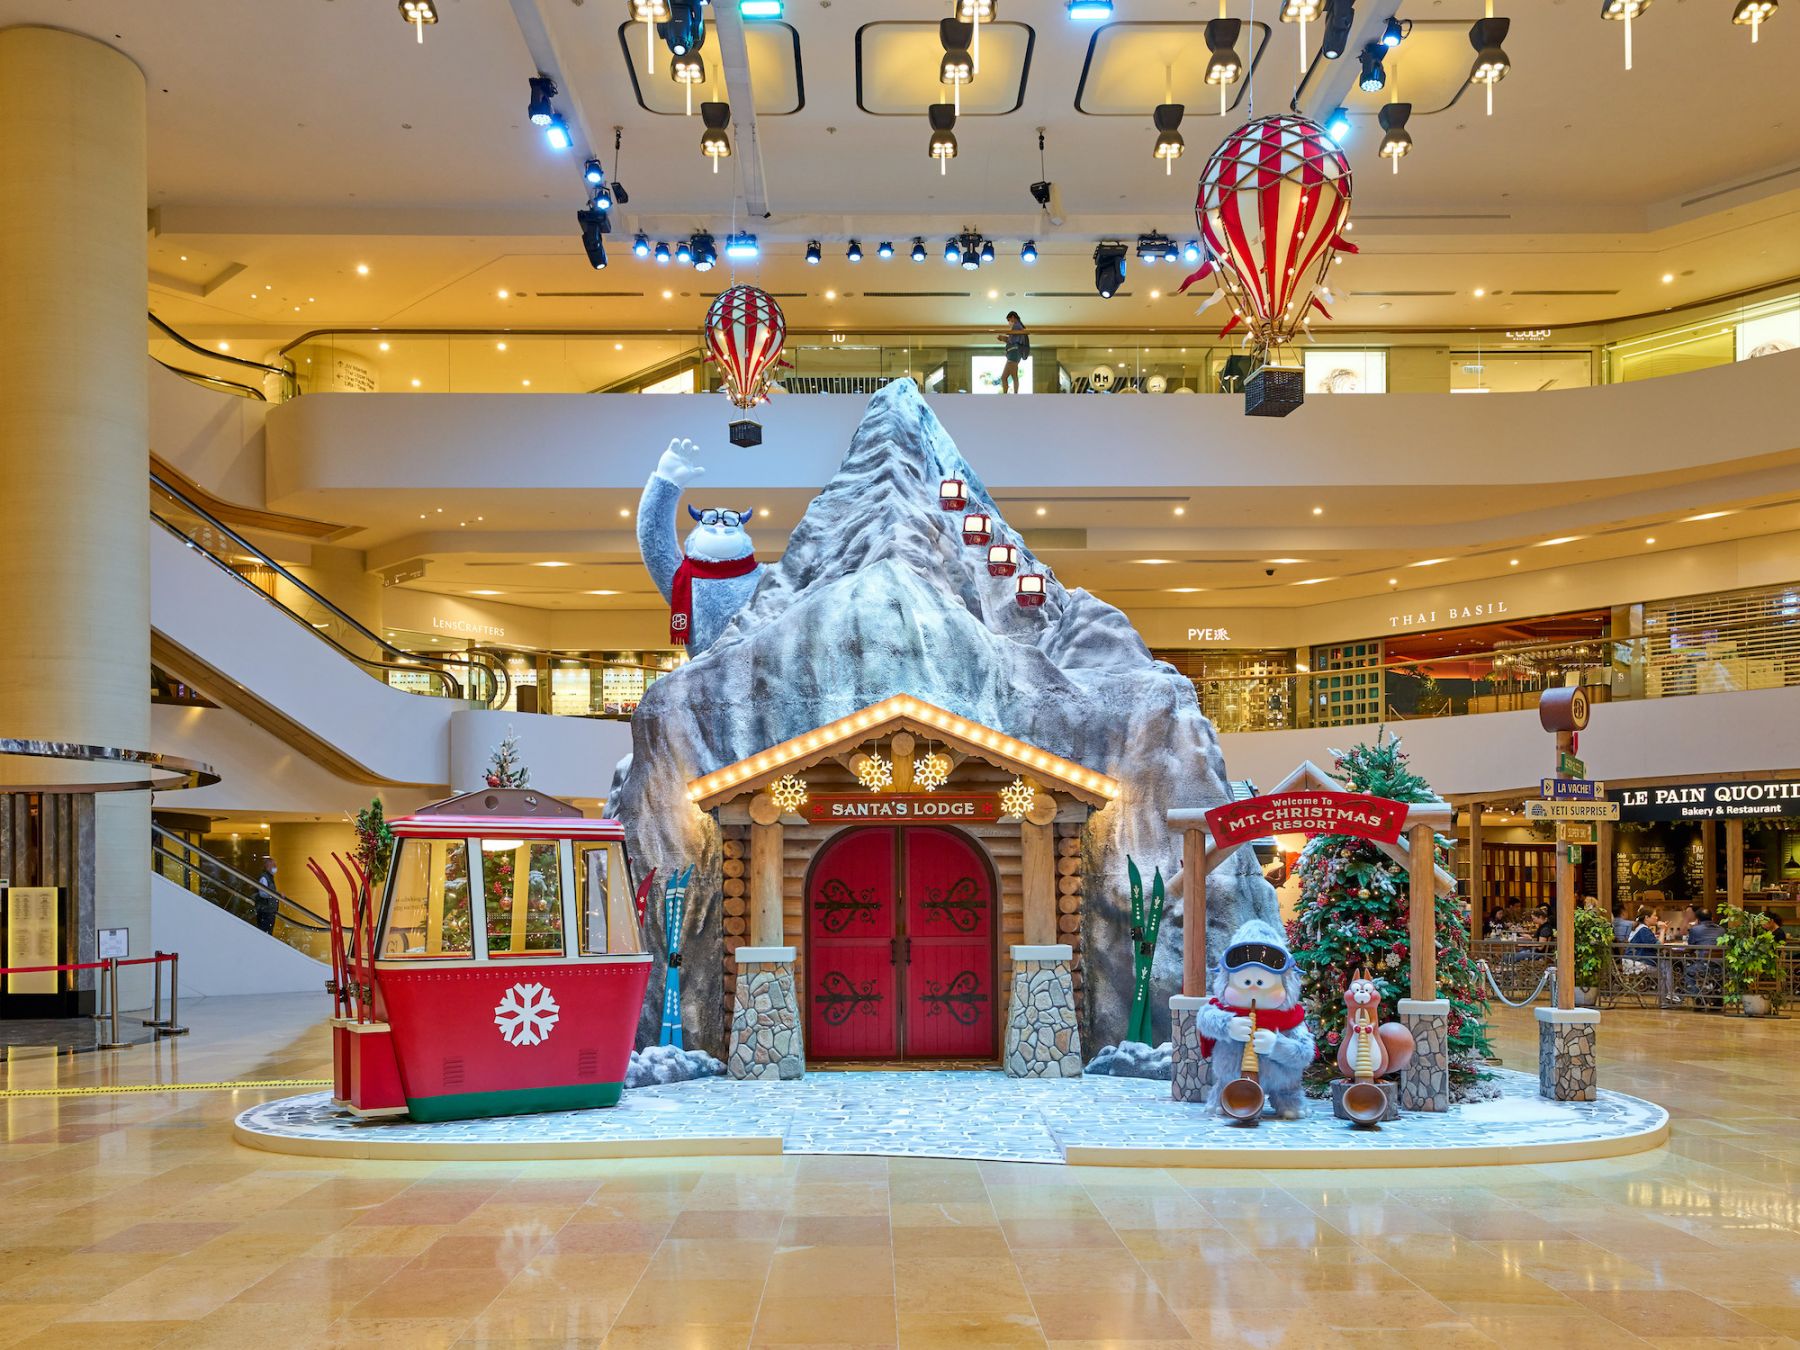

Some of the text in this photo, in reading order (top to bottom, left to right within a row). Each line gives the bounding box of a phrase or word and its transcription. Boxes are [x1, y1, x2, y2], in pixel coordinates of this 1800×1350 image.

[1389, 601, 1508, 627] THAI BASIL
[1557, 783, 1592, 795] LA VACHE!
[1272, 797, 1333, 807] Welcome To
[1623, 791, 1648, 806] LE
[1655, 788, 1706, 805] PAIN
[832, 801, 975, 816] SANTA'S LODGE
[1550, 805, 1607, 816] YETI SURPRISE
[1681, 804, 1782, 817] Bakery & Restaurant
[1261, 806, 1382, 828] CHRISTMAS
[1272, 820, 1337, 831] RESORT
